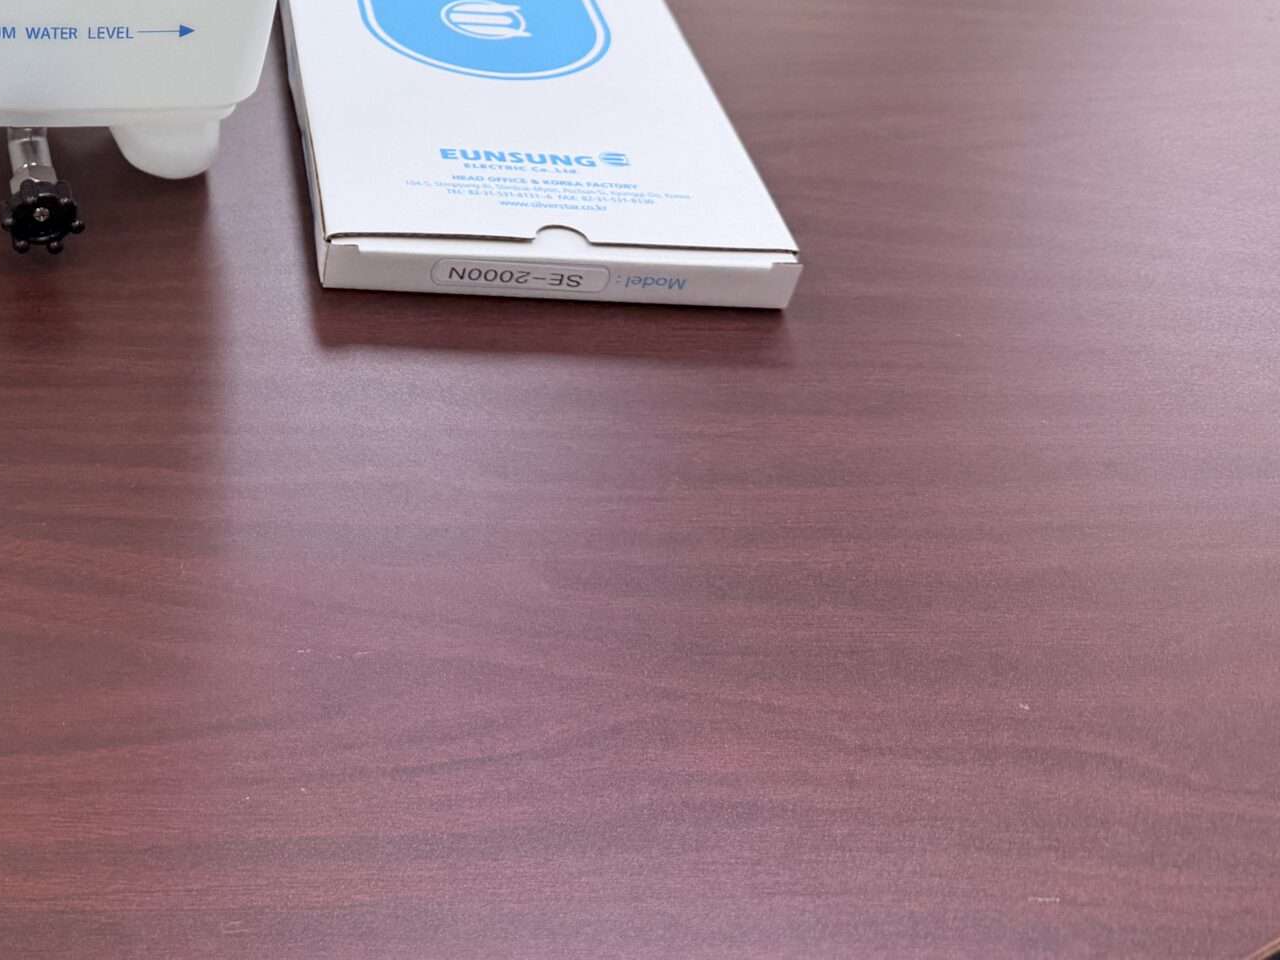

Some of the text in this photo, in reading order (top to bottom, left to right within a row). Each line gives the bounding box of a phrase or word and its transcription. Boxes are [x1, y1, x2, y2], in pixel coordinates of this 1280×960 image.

[25, 26, 78, 40] WATER
[87, 26, 134, 40] LEVEL
[439, 148, 597, 167] EUNSUNG
[451, 174, 485, 182] HEAD
[487, 176, 528, 184] OFFICE
[585, 181, 638, 190] FACTORY
[448, 266, 584, 289] SE-2000N
